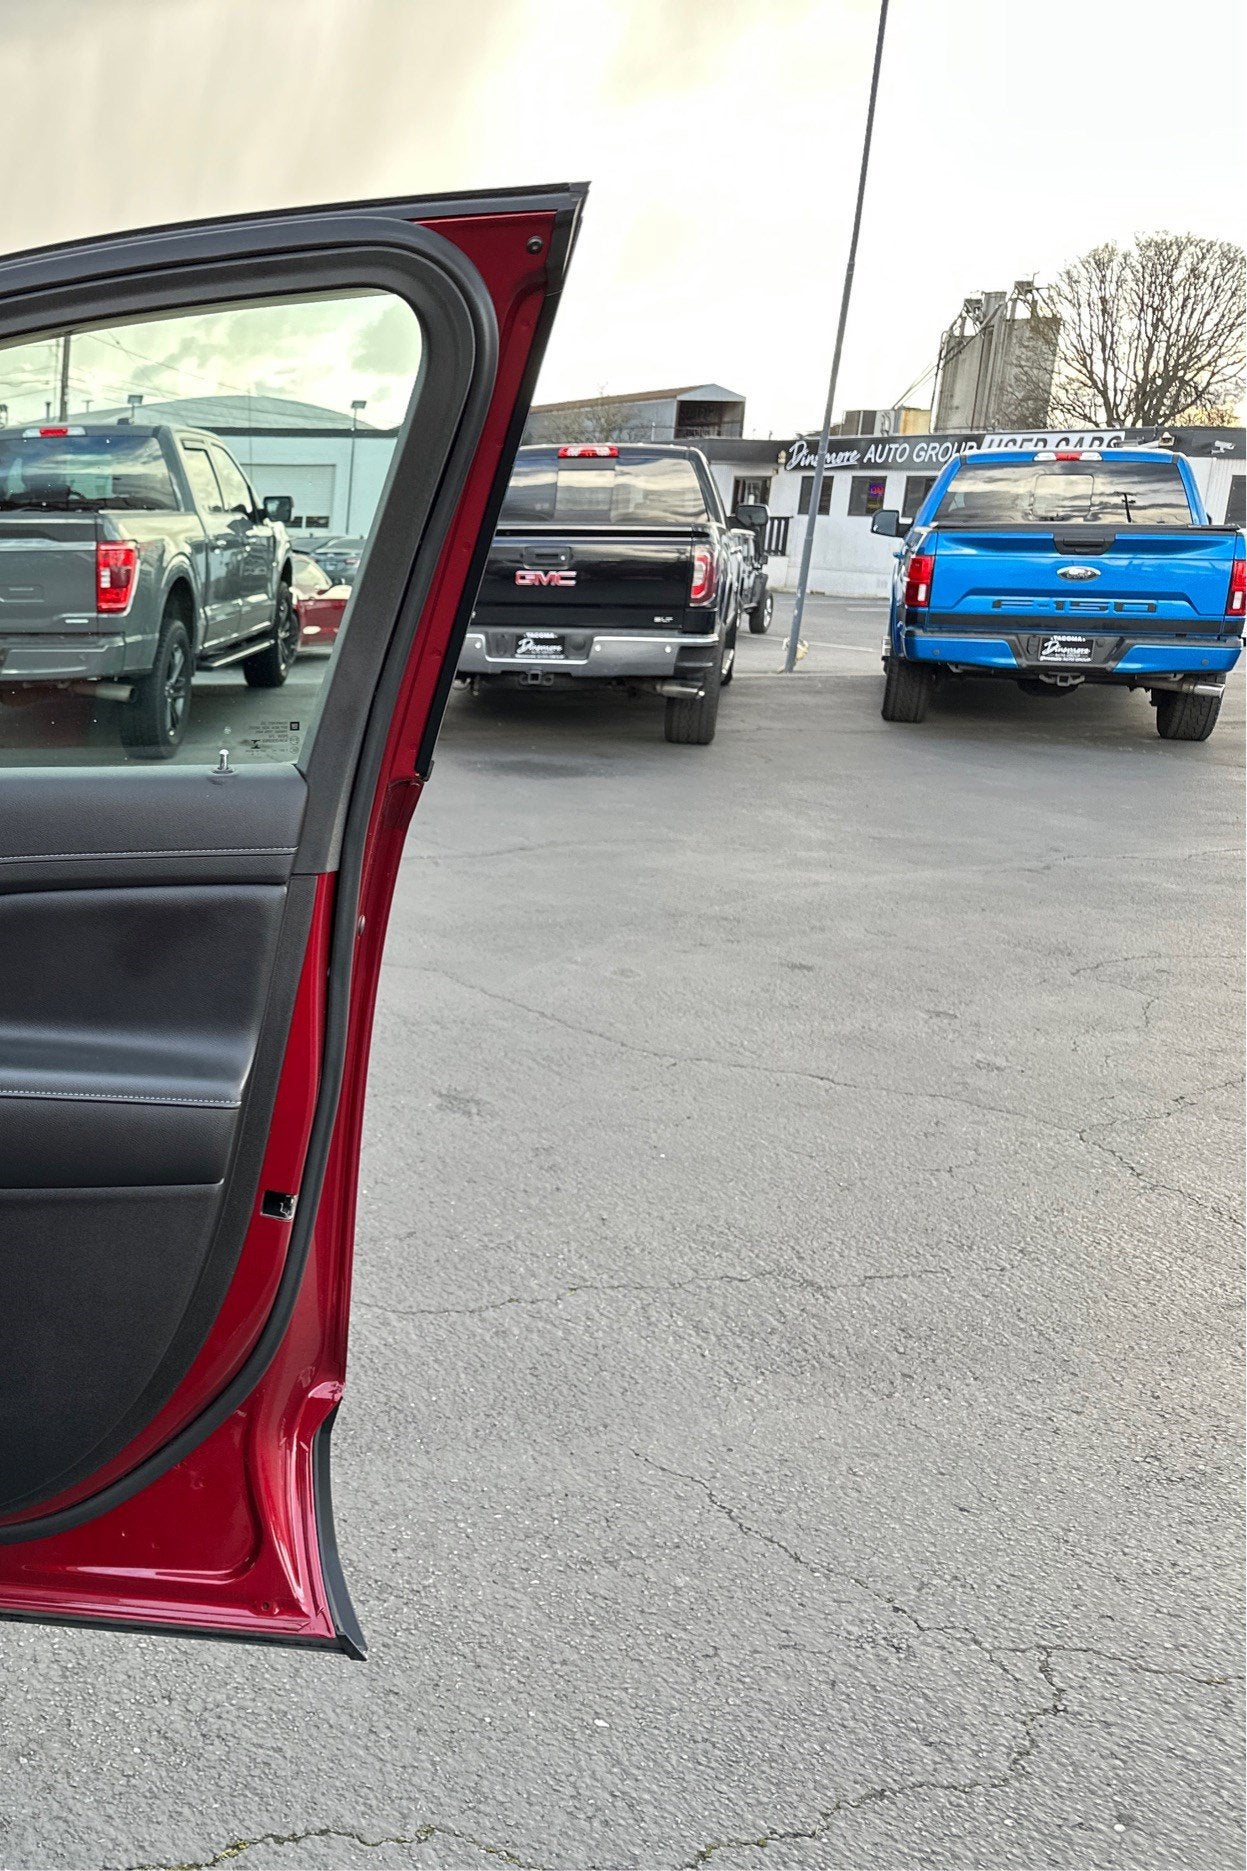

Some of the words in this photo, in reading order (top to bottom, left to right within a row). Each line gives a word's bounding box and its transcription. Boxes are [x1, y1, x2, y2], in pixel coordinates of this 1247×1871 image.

[785, 440, 861, 471] Dinmore
[863, 443, 908, 464] AUTO
[912, 441, 978, 464] GROUP
[515, 570, 578, 587] GMC
[991, 599, 1158, 613] F-150
